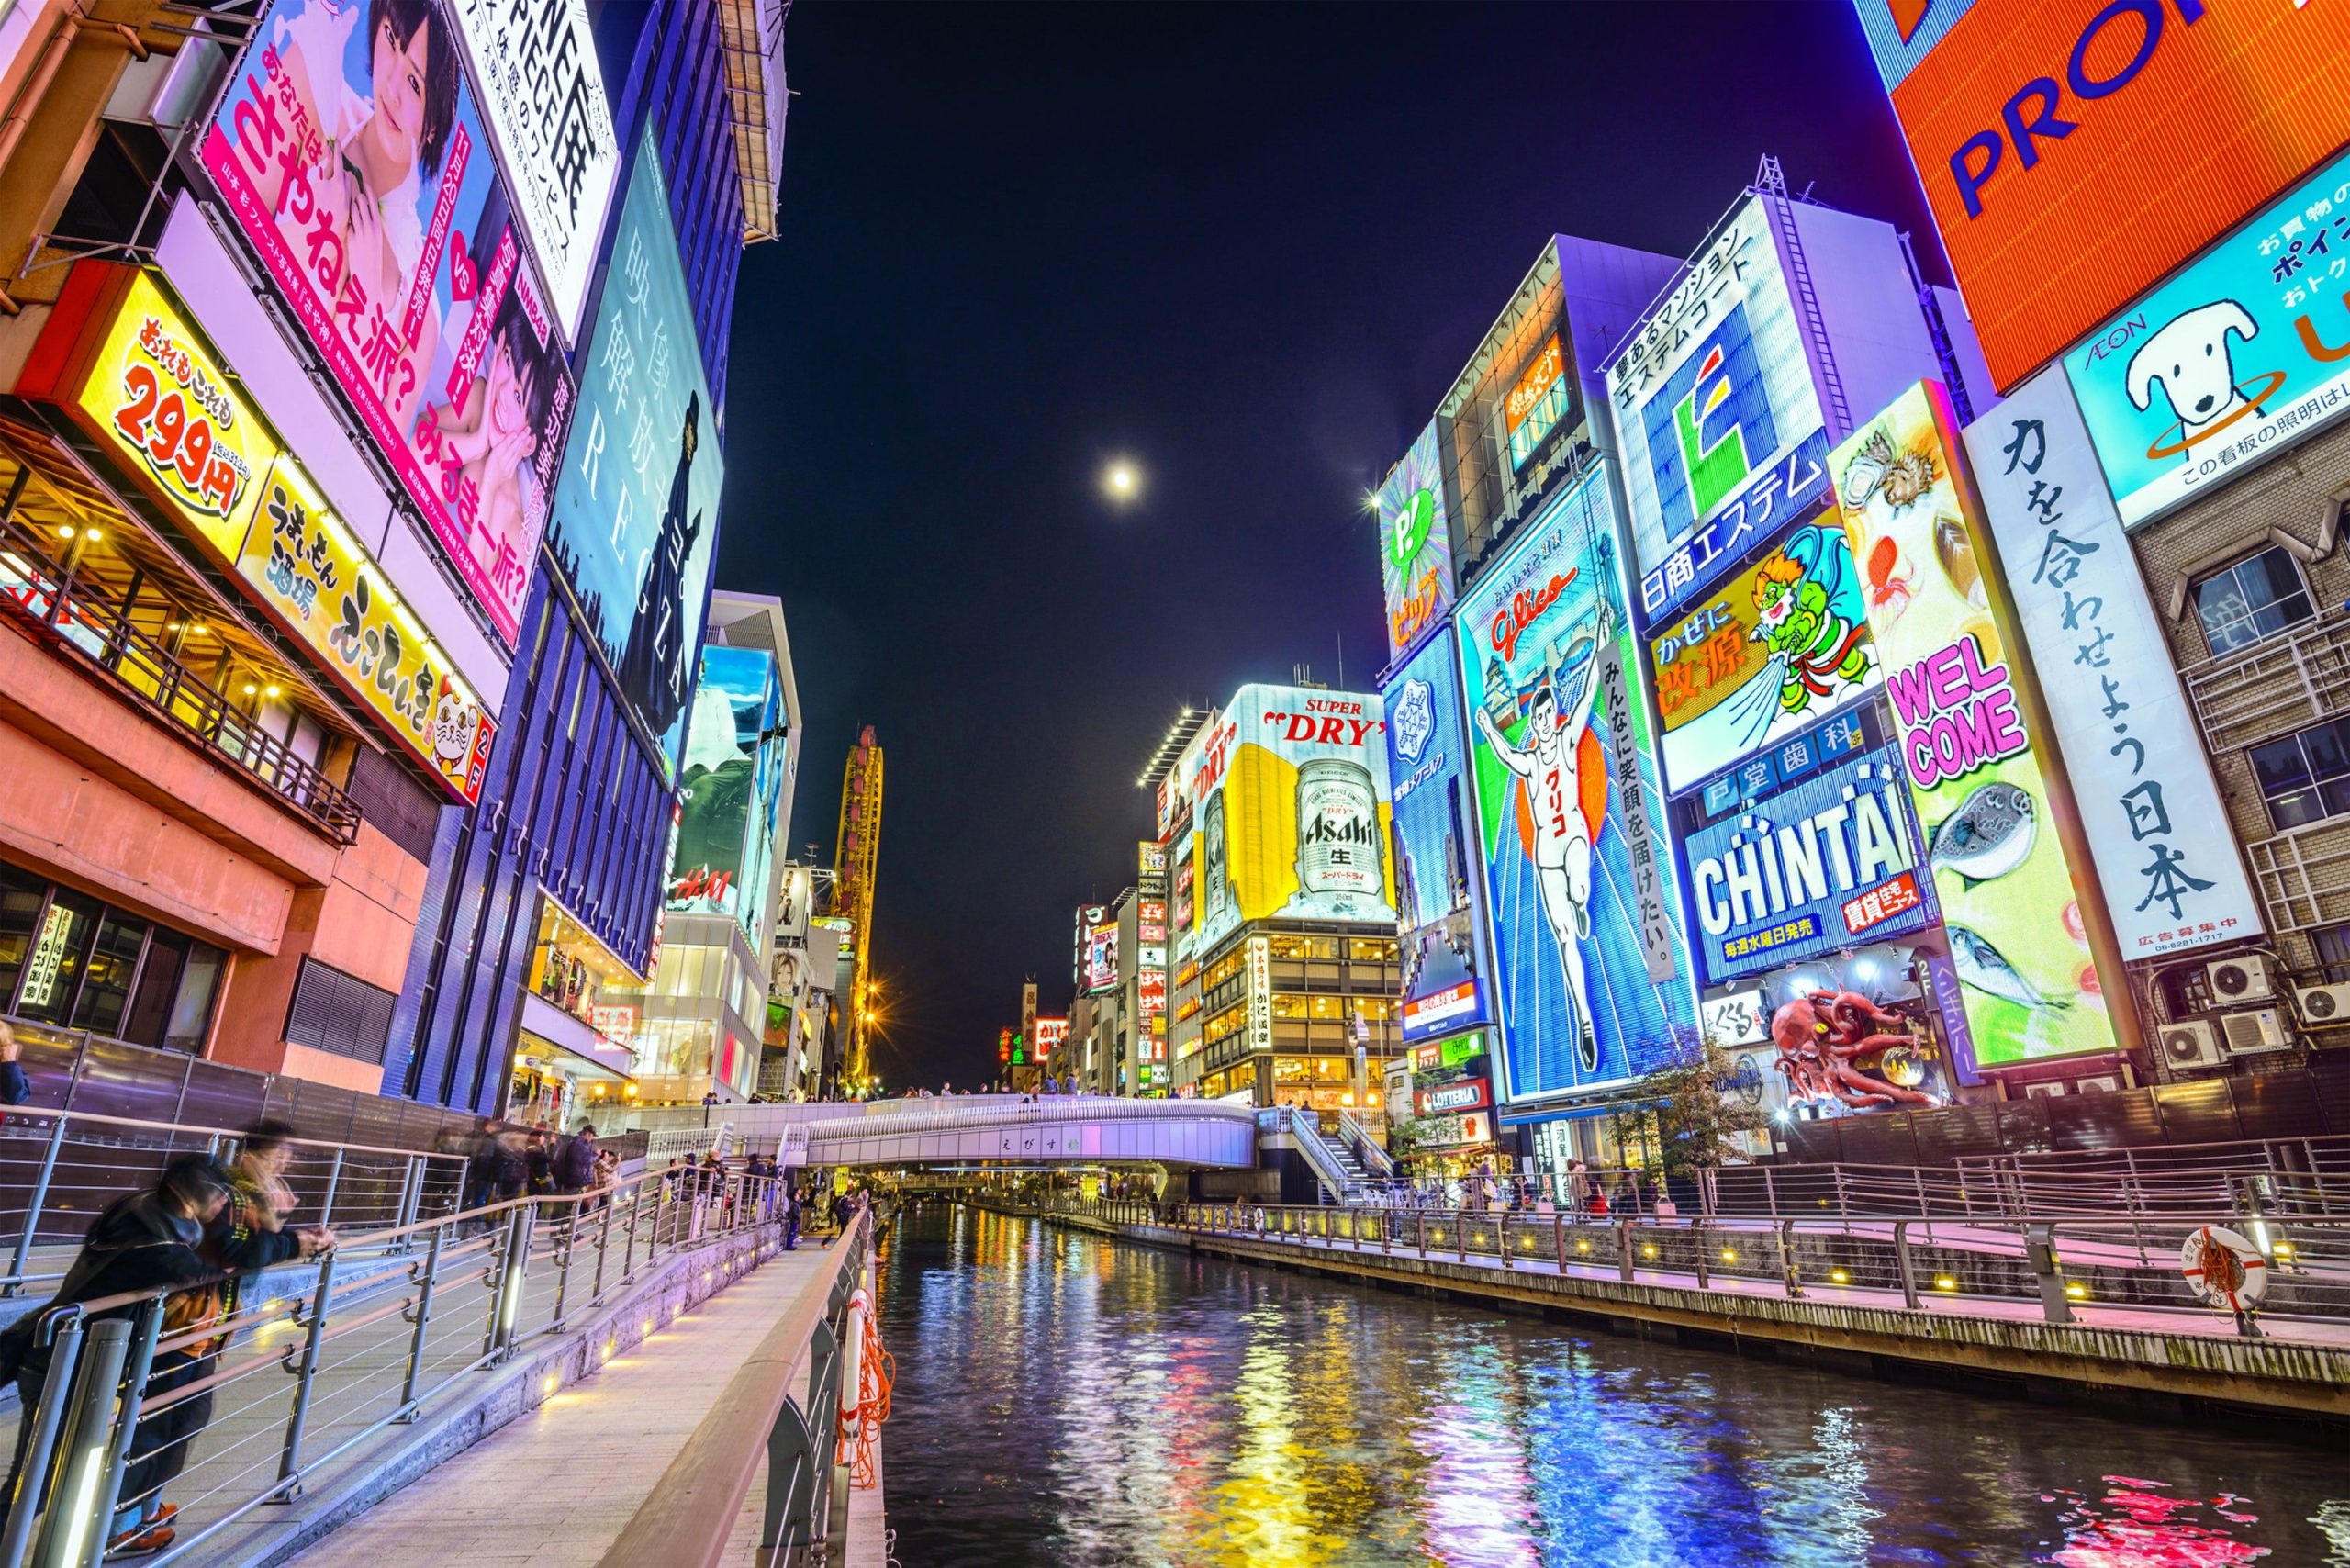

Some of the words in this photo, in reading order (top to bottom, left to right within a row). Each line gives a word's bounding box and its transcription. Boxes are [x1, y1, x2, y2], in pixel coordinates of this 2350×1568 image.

[1949, 0, 2205, 220] PRO
[408, 129, 470, 339] 11月20日同日発売!
[453, 252, 471, 295] VS
[516, 271, 550, 346] NMB48
[1614, 227, 1741, 385] 夢あるマンション
[452, 230, 517, 405] 写真集対決!
[1620, 258, 1751, 411] エステムコート
[115, 364, 237, 518] 299円
[269, 485, 338, 590] うまいもん
[579, 401, 685, 704] REGZA
[1639, 451, 1825, 614] 日商エステム
[1392, 565, 1439, 650] ピップ
[1491, 562, 1580, 664] Glico
[1656, 599, 1733, 666] かぜに
[1304, 698, 1363, 715] SUPER
[1656, 622, 1747, 718] 改源
[2002, 418, 2220, 922] 力を合わせよう日本
[1305, 812, 1374, 847] Asahi
[1544, 762, 1567, 839] グリコ
[1602, 658, 1669, 963] みんなに笑顔を届けたい。
[674, 868, 733, 904] H&M
[1321, 871, 1365, 882] スーパードライ
[1330, 847, 1352, 866] 生
[1694, 780, 1915, 936] CHINTAI
[1723, 917, 1815, 959] 毎週水曜日発売
[1843, 891, 1886, 933] 賃貸
[1878, 880, 1904, 902] 住宅
[1883, 890, 1919, 915] ニュース
[2137, 917, 2238, 947] 広告募集中
[1919, 959, 1932, 997] 2F
[2154, 932, 2223, 953] 06-6281-1717
[1715, 1001, 1753, 1039] くくる
[1431, 1086, 1476, 1108] LOTTERIA
